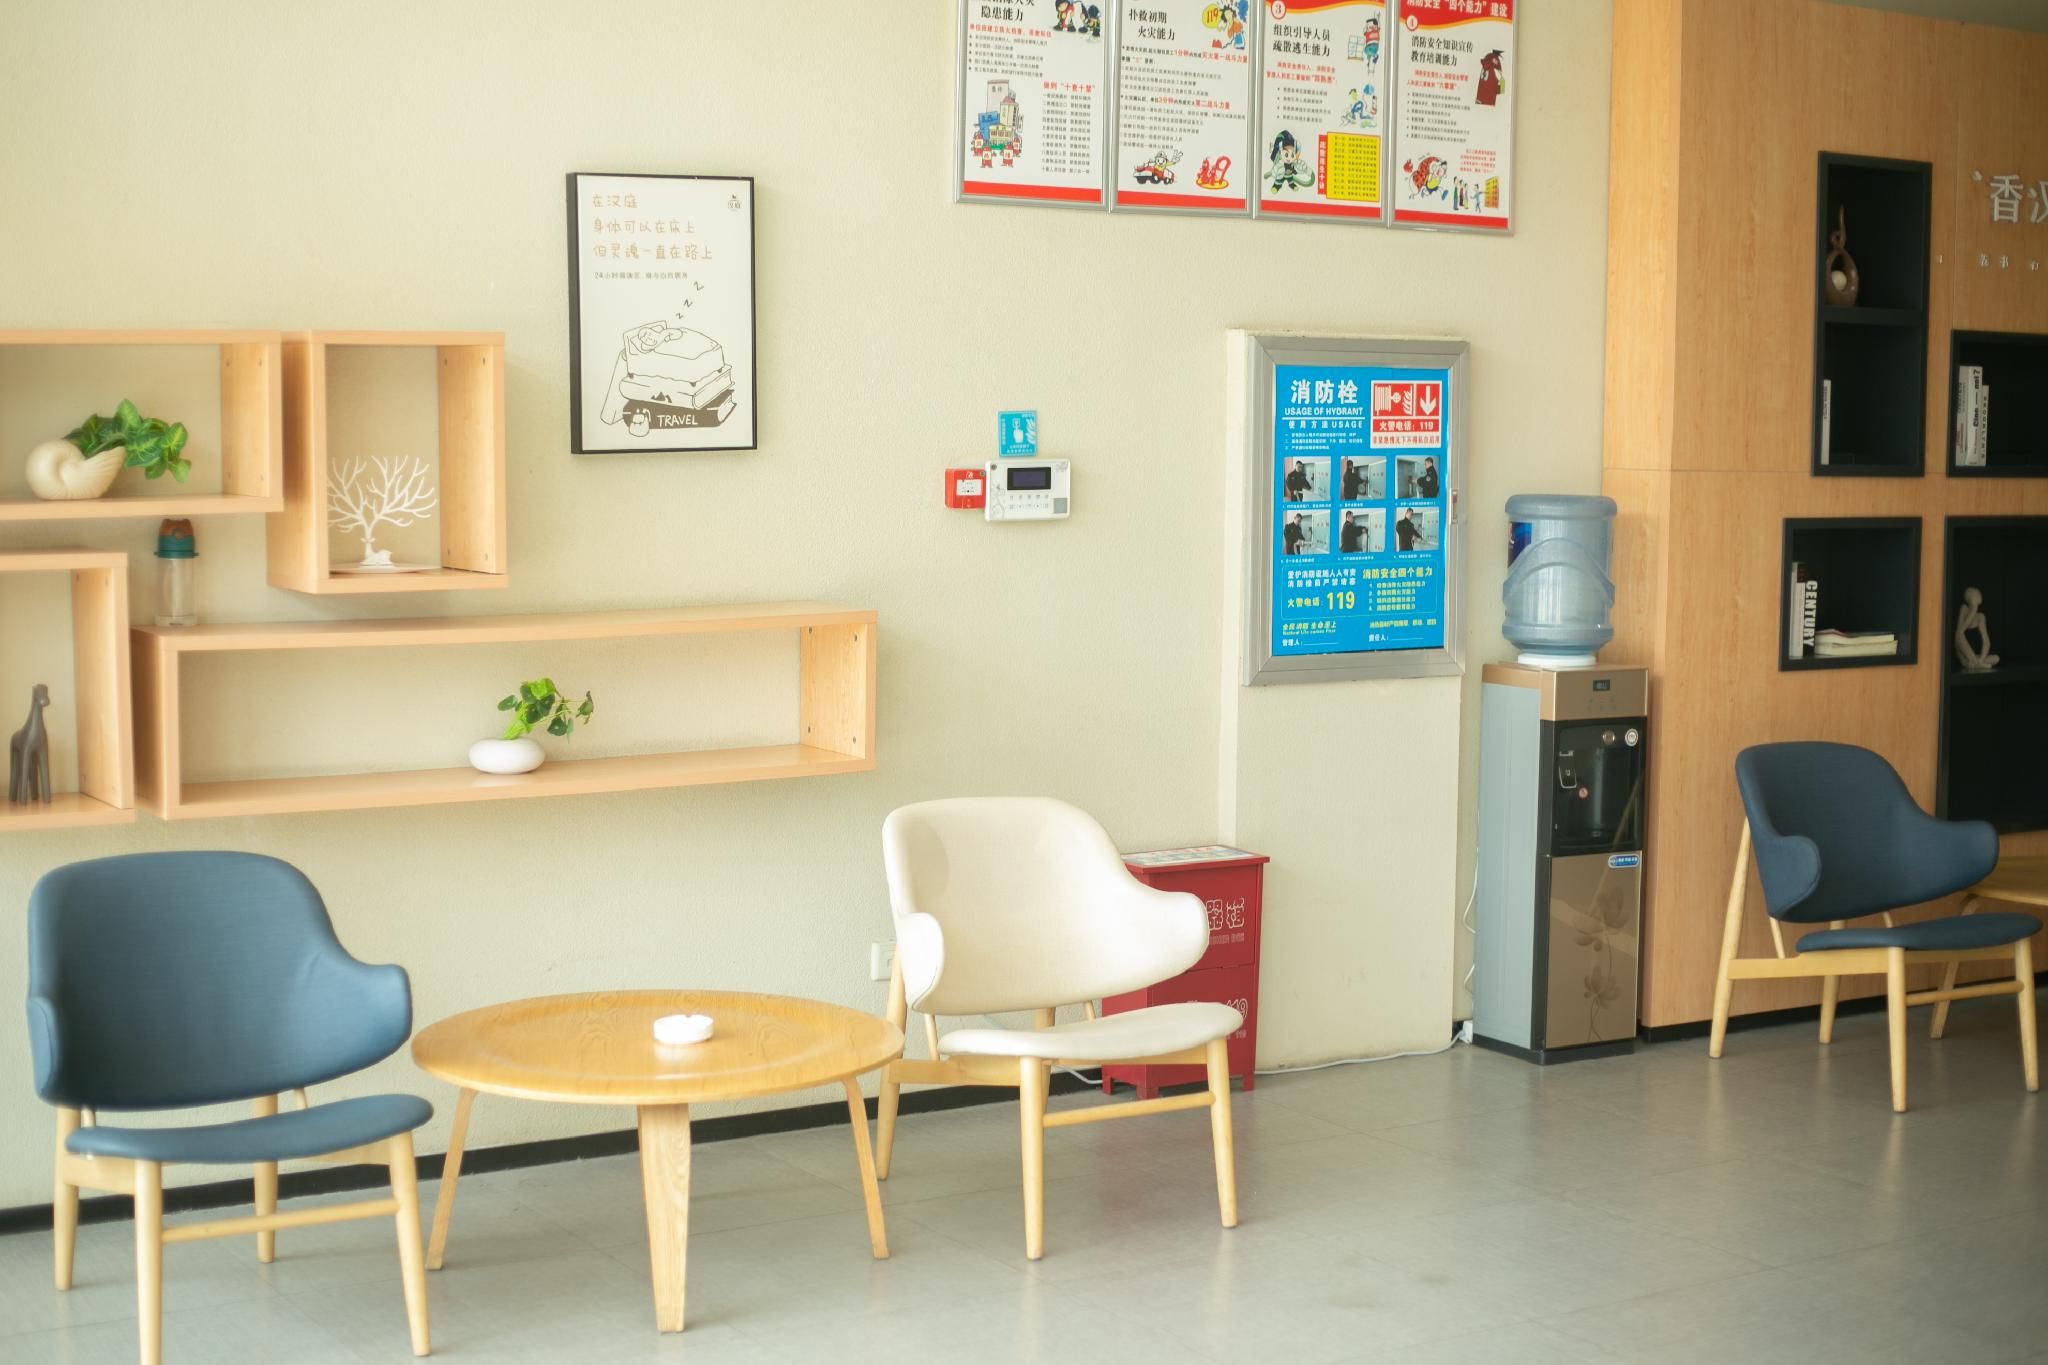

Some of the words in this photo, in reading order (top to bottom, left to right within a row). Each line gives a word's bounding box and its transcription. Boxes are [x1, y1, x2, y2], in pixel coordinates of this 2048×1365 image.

[981, 5, 1023, 21] 隐患能力
[1129, 8, 1167, 24] 扑救初期
[1138, 25, 1175, 40] 火灾能力
[1273, 24, 1330, 41] 组织引导人员
[1273, 40, 1330, 57] 疏散逃生能力
[1411, 35, 1473, 53] 消防安全知识宣传
[1411, 50, 1458, 67] 教育培训能力
[592, 193, 638, 208] 在汉庭
[593, 218, 696, 234] 身体可以在床上
[593, 242, 713, 260] 但灵魂一直在路上
[1290, 379, 1359, 405] 消防栓
[1284, 407, 1312, 416] USAGE
[1314, 407, 1324, 416] OF
[1325, 407, 1363, 416] HYDRANT
[657, 414, 698, 427] TRAVEL
[1331, 420, 1363, 429] USAGE
[1326, 591, 1356, 610] 119
[1803, 580, 1818, 647] CENTURY
